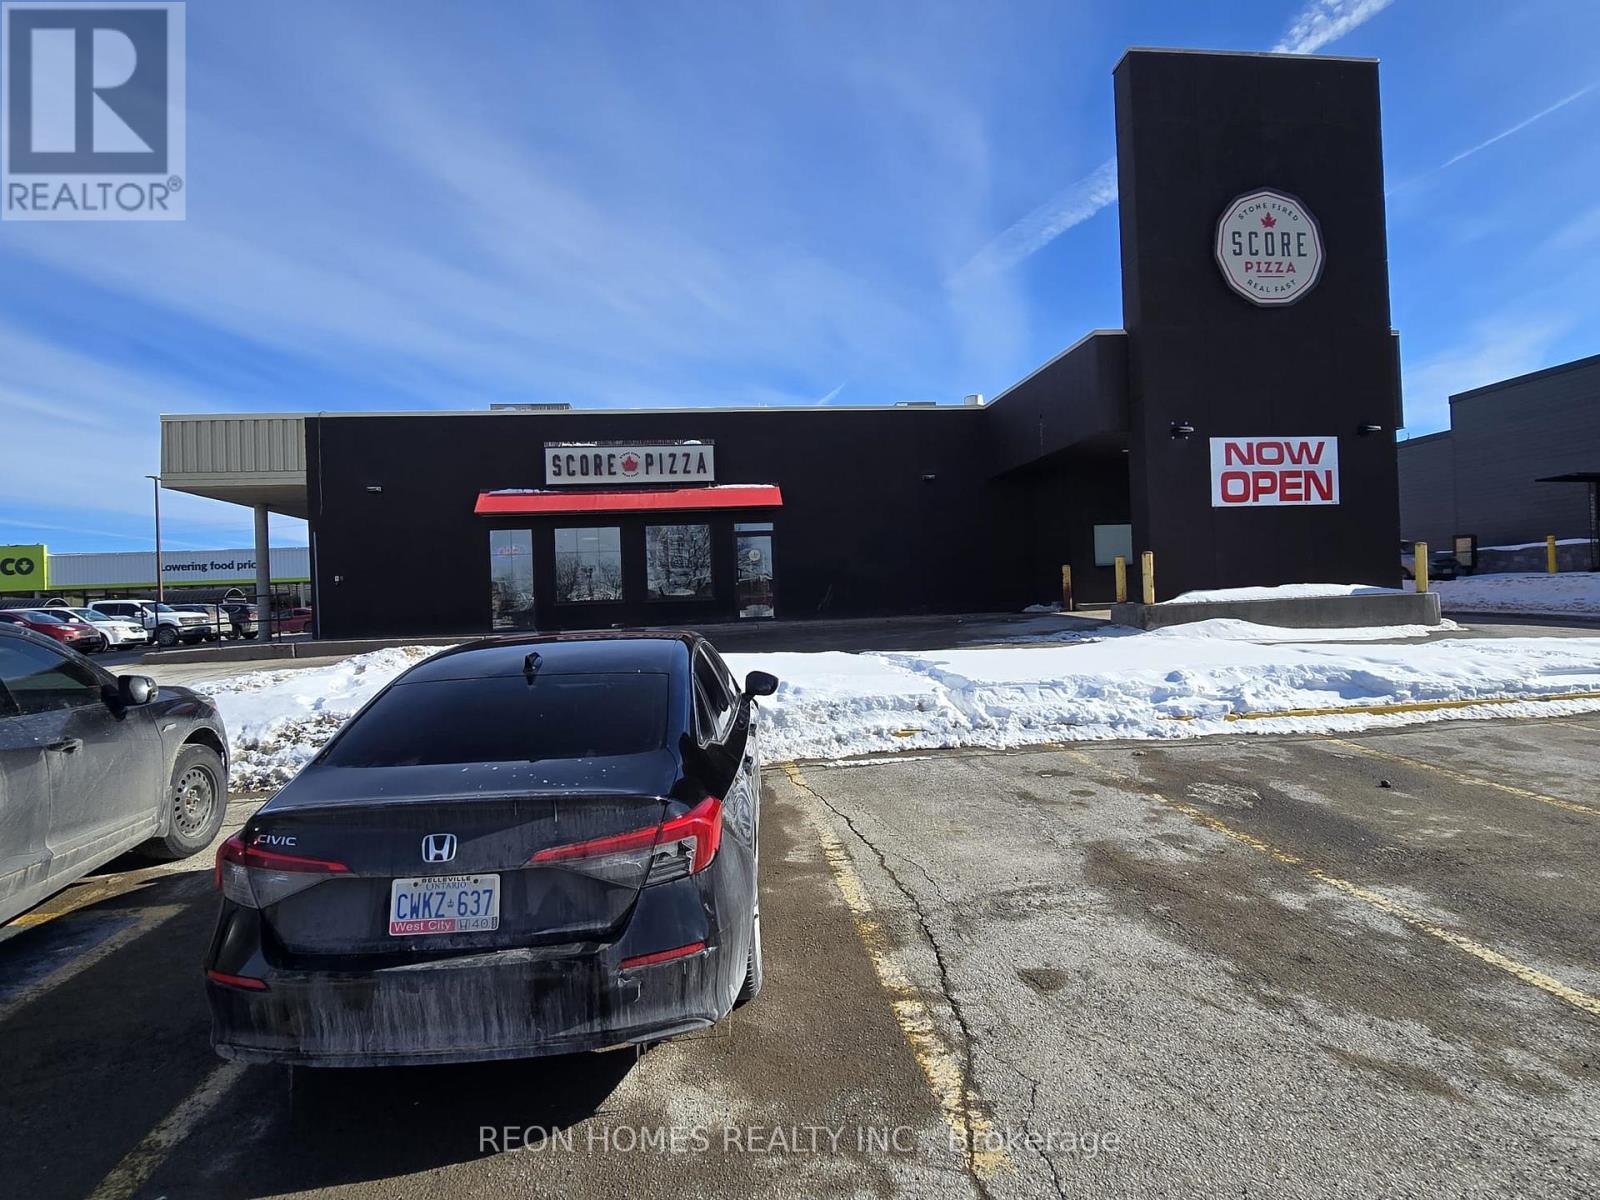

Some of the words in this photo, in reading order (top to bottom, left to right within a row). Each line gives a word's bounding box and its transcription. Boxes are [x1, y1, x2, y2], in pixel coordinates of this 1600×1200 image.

[1272, 203, 1299, 221] FIRED
[1231, 231, 1308, 257] SCORE
[1244, 261, 1296, 273] PIZZA
[1247, 279, 1271, 293] REAL
[1274, 279, 1297, 293] FAST
[1224, 441, 1326, 465] NOW
[552, 453, 617, 477] SCORE
[645, 452, 707, 475] PIZZA
[1220, 469, 1333, 503] OPEN
[210, 560, 234, 570] food
[257, 834, 297, 846] CIVIC
[421, 876, 471, 884] BELLEVILLE
[425, 881, 467, 891] ONTARIO
[394, 922, 424, 933] West
[428, 920, 452, 931] City
